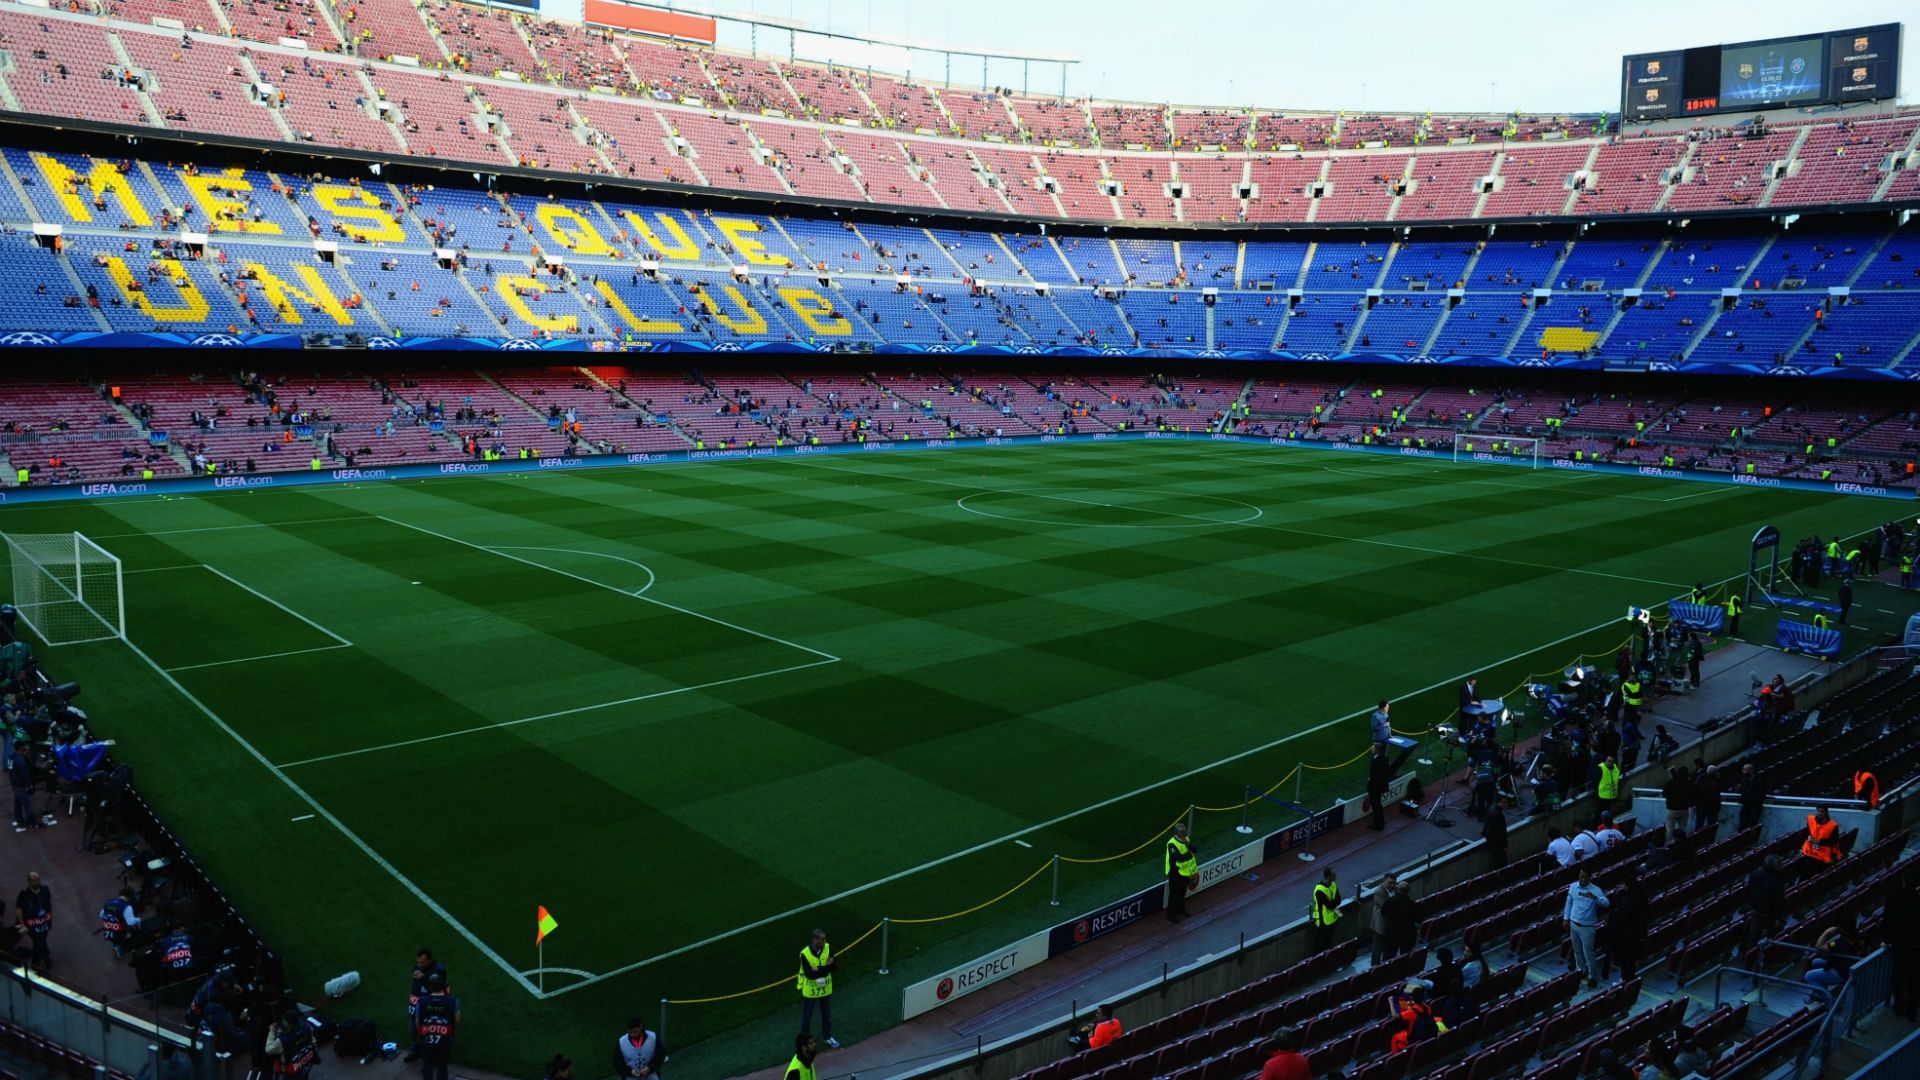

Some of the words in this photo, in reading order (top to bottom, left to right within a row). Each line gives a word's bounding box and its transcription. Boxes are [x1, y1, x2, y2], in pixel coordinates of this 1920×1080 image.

[536, 203, 790, 266] QUE
[106, 256, 354, 326] UN
[495, 275, 852, 336] CLUB
[1041, 434, 1068, 443] UEFA.com
[1144, 431, 1176, 439] UEFA.com
[1211, 433, 1240, 441] UEFA.com
[864, 441, 895, 450] UEFA.com
[927, 439, 957, 447] UEFA.com
[985, 437, 1013, 445] UEFA.com
[1270, 437, 1299, 446] UEFA.com
[794, 445, 829, 454] UEFA.com
[1332, 442, 1365, 451] UEFA.com
[691, 450, 710, 459] UEFA
[710, 449, 748, 458] CHAMPIONS
[1400, 447, 1435, 457] UEFA.com
[1473, 452, 1511, 462] UEFA.com
[539, 458, 582, 467] UEFA.com
[628, 453, 668, 462] UEFA.com
[440, 463, 489, 473] UEFA.com
[1552, 458, 1593, 469] UEFA.com
[333, 469, 386, 480] UEFA.com
[1639, 466, 1684, 478] UEFA.com
[215, 475, 273, 488] UEFA.com
[1733, 474, 1780, 486] UEFA.com
[82, 482, 147, 496] UEFA.com
[1834, 482, 1887, 495] UEFA.com
[1202, 854, 1244, 884] RESPECT
[1092, 898, 1144, 933] RESPECT
[958, 951, 1019, 990] RESPECT
